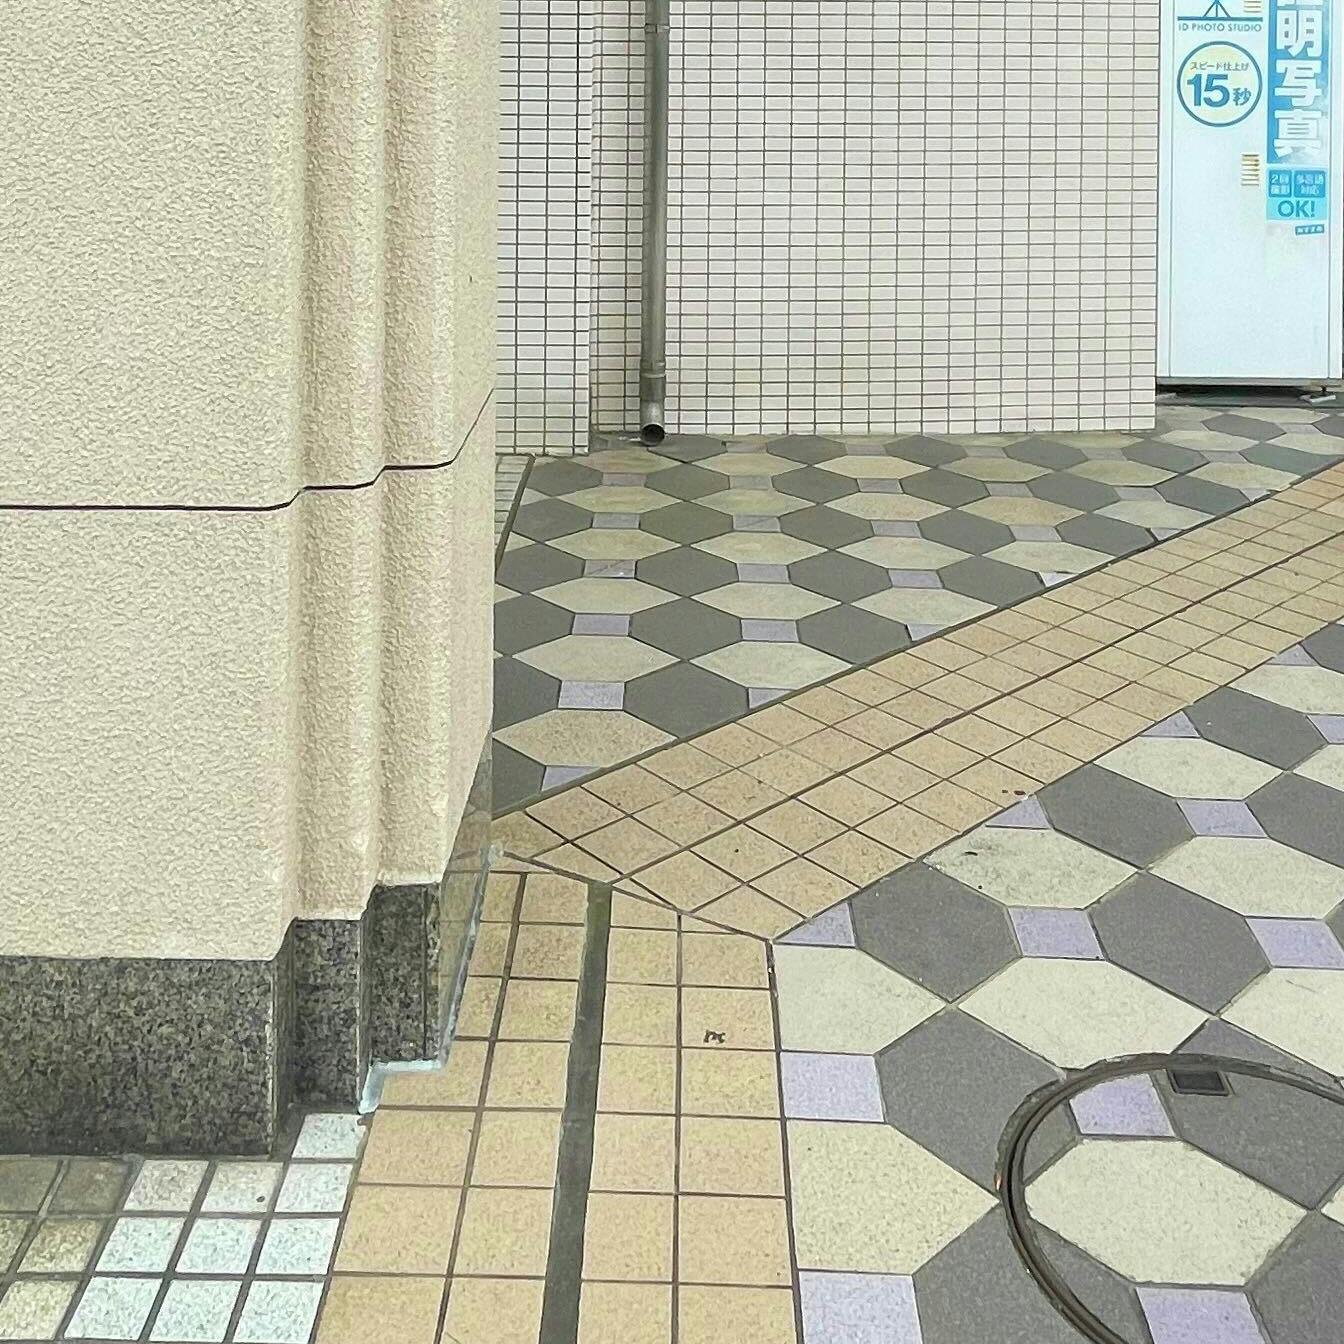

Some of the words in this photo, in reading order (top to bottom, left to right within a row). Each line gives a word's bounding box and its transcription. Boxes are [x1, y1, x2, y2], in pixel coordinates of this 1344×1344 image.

[1178, 22, 1189, 32] ID
[1191, 22, 1226, 32] PHOTO
[1227, 23, 1262, 33] STUDIO
[1277, 199, 1315, 218] OK!
